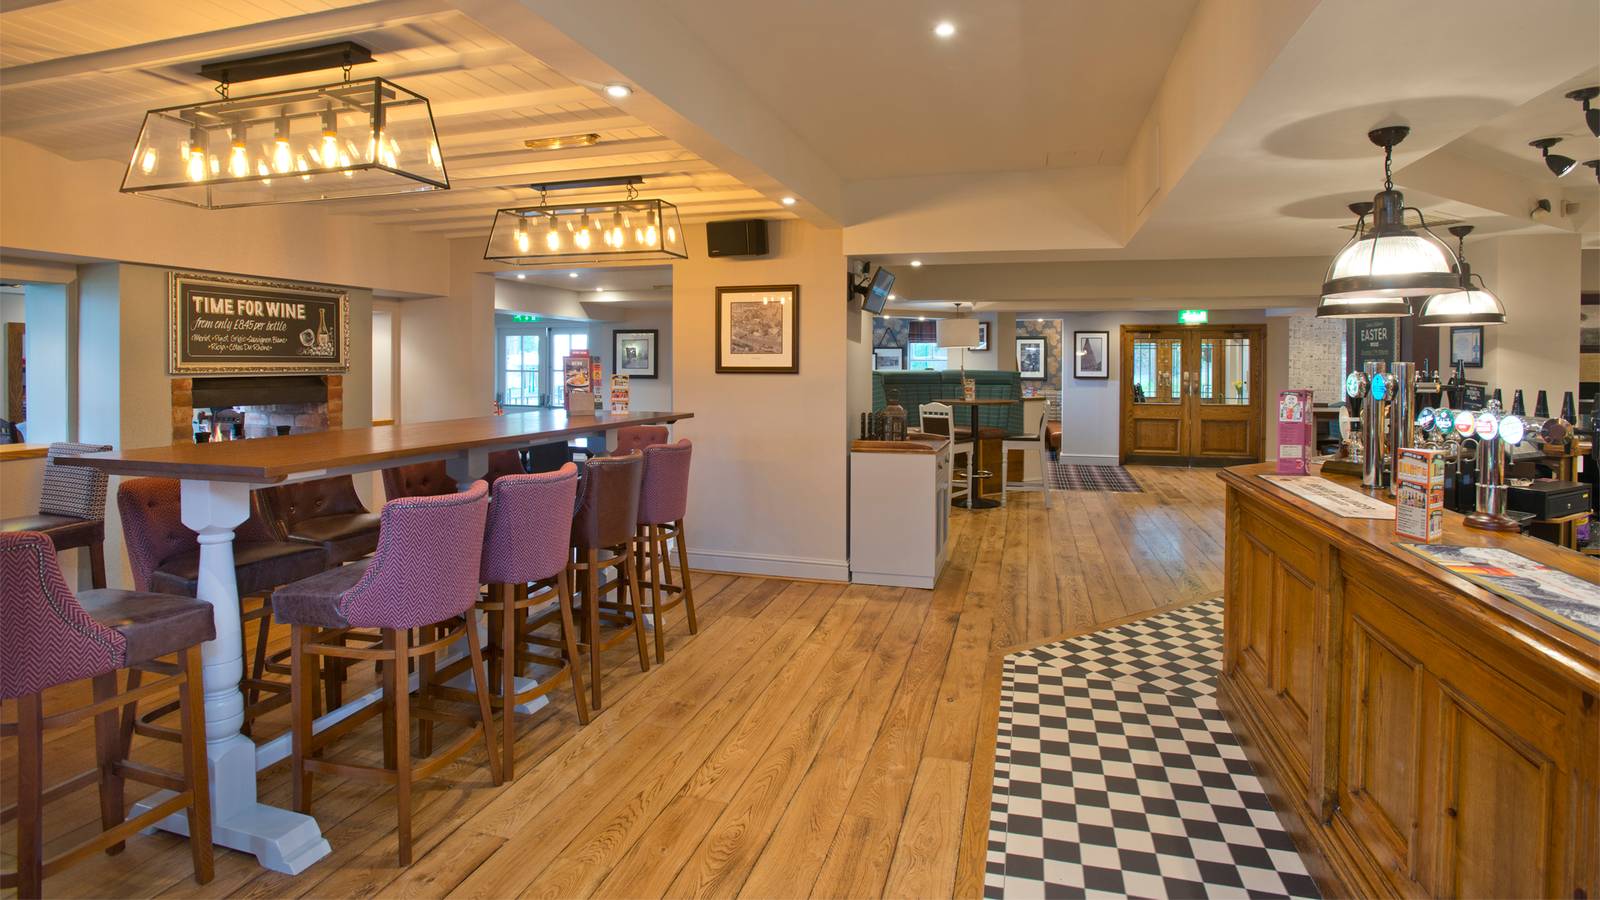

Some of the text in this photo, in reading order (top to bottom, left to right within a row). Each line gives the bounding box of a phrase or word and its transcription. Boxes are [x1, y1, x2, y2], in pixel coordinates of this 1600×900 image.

[192, 295, 306, 320] TIME FOR WINE
[191, 317, 213, 331] from
[214, 318, 233, 331] only
[253, 322, 266, 331] per
[265, 320, 287, 331] bottle
[1361, 327, 1388, 341] EASTER
